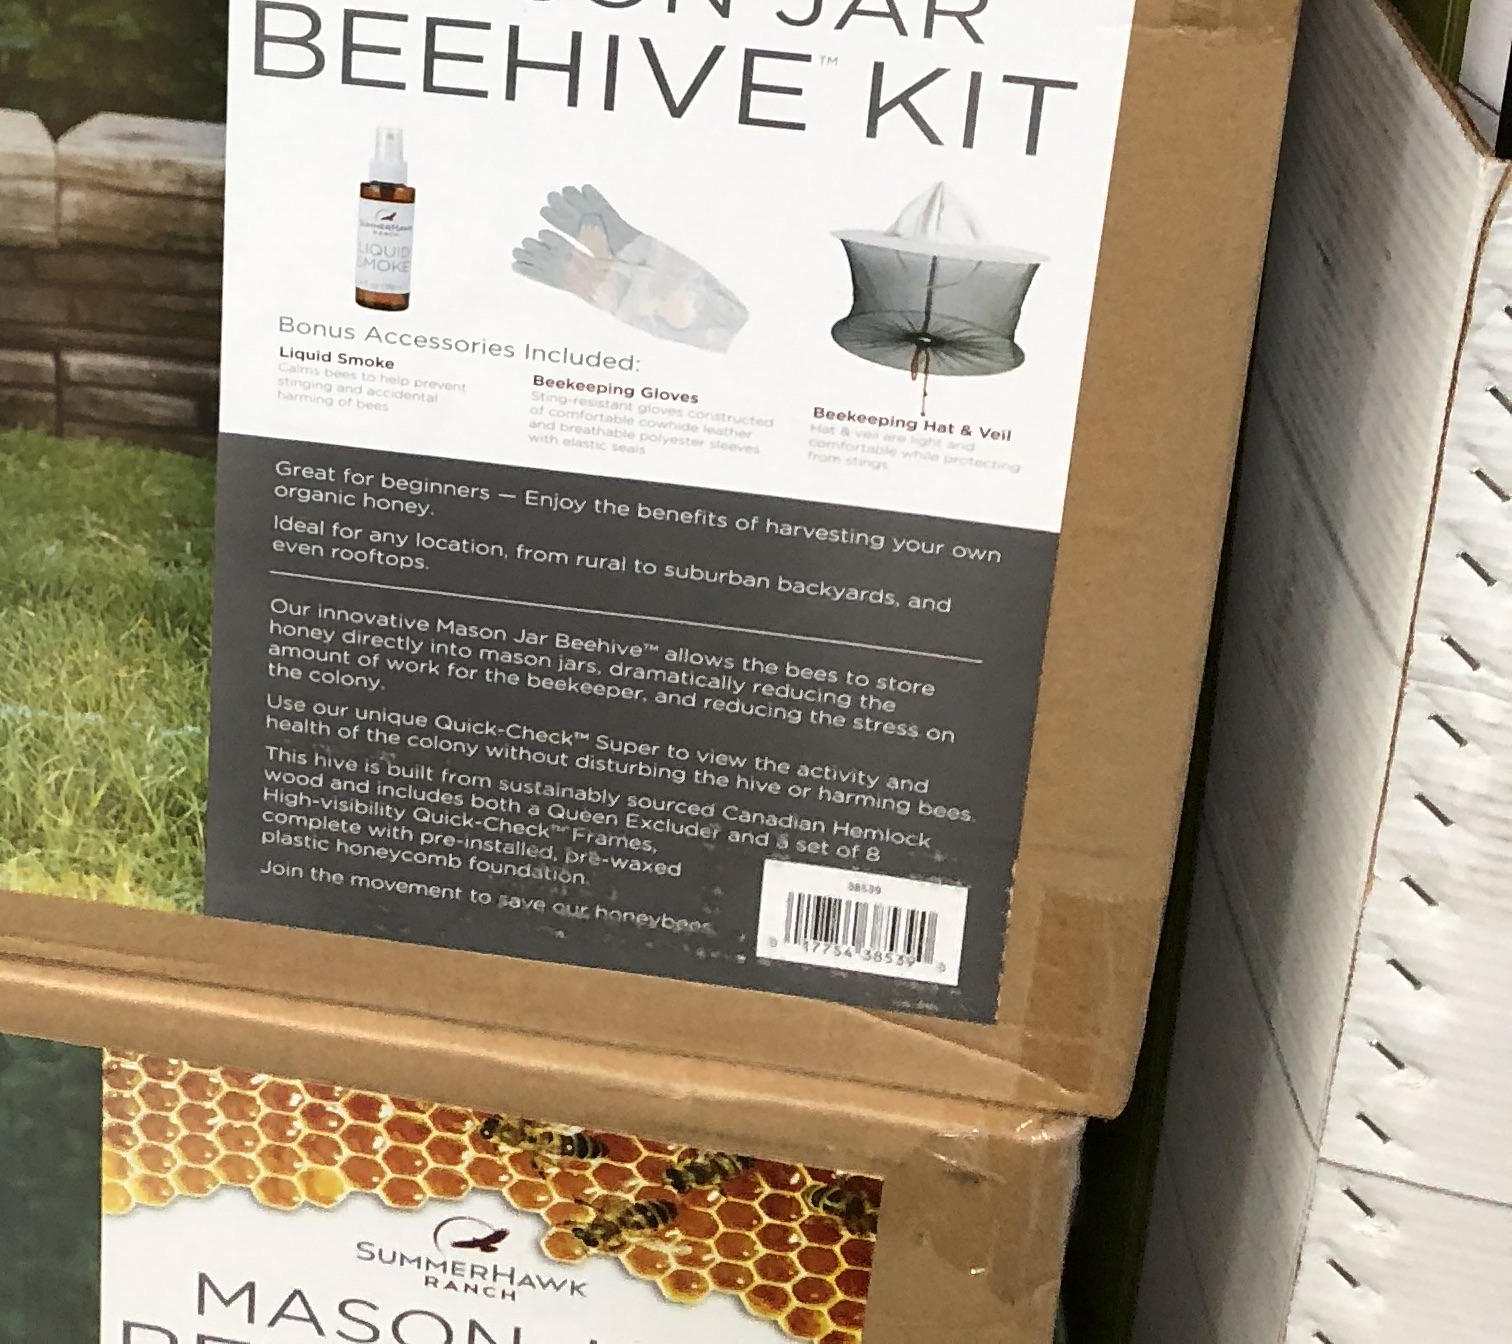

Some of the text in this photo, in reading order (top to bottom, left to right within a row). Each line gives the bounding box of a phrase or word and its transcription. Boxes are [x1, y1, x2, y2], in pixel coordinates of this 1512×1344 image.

[866, 61, 1078, 156] KIT
[280, 316, 640, 372] Bonus Accessories Included:
[280, 346, 394, 369] Liquid Smoke
[533, 375, 698, 404] Beekeeping Gloves
[814, 407, 1011, 441] Beekeeping Hat & Veil
[276, 461, 1001, 562] Great for beginners Enjoy the benefits of harvesting your own
[424, 1275, 516, 1301] RANCH
